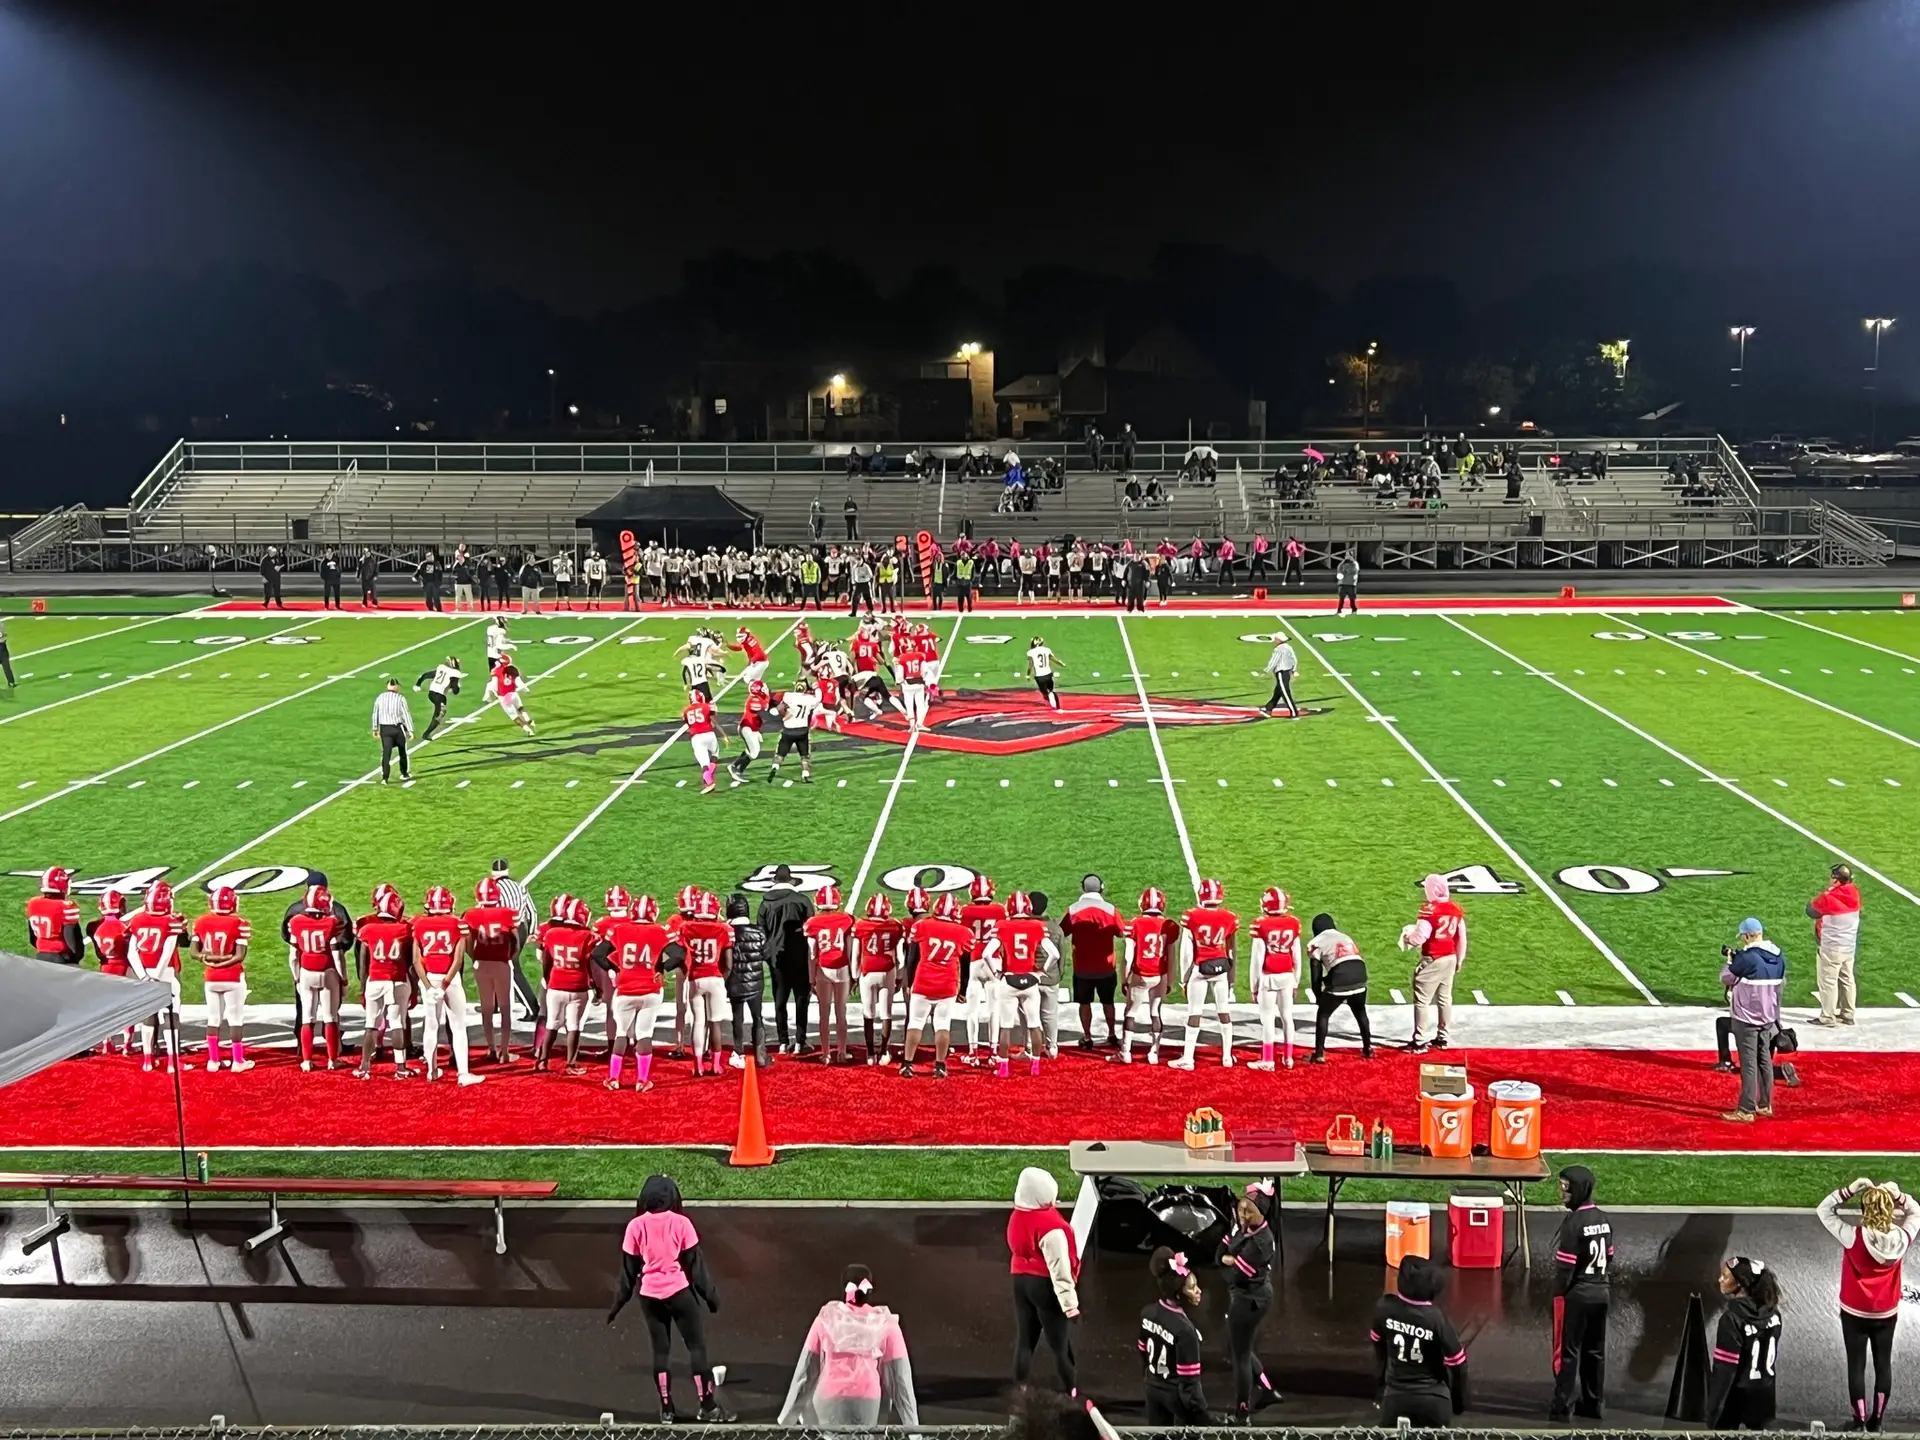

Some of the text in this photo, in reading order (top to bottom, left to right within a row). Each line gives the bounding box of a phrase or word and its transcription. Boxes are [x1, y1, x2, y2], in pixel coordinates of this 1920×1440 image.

[693, 663, 703, 678] 12
[686, 708, 705, 725] 65
[796, 704, 807, 719] 71
[137, 927, 162, 955] 27
[203, 931, 228, 956] 47
[301, 929, 326, 953] 10
[423, 930, 453, 957] 23
[818, 927, 844, 952] 84
[1014, 933, 1028, 960] 5
[1197, 925, 1225, 948] 34
[1267, 929, 1294, 954] 82
[373, 939, 401, 963] 44
[622, 942, 653, 970] 64
[927, 937, 956, 965] 77
[1441, 1111, 1458, 1129] G
[1508, 1111, 1525, 1129] G
[1585, 1237, 1607, 1275] 24
[1142, 1318, 1174, 1345] SENIOR
[1386, 1318, 1434, 1341] SENIOR
[1146, 1337, 1170, 1379] 24
[1393, 1334, 1424, 1364] 24
